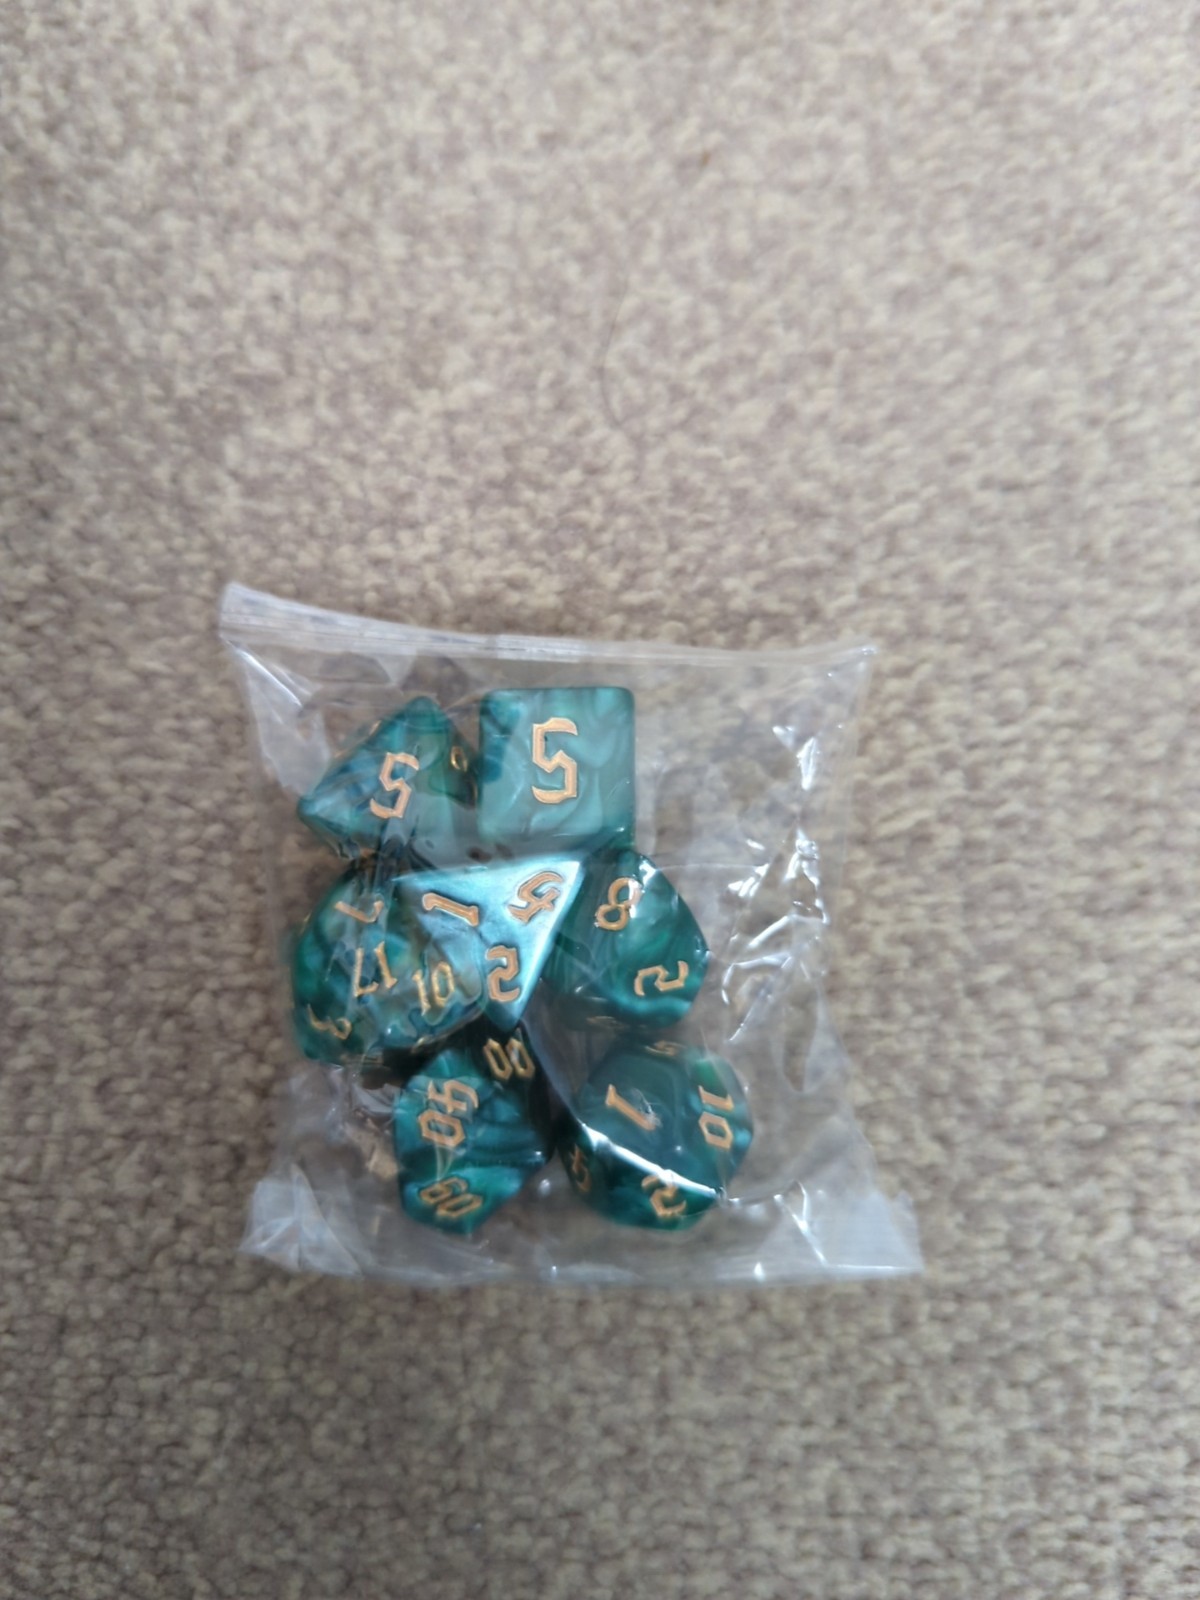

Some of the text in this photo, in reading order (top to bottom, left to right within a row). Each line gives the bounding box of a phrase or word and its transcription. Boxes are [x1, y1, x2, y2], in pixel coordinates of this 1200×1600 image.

[369, 752, 419, 819] 5
[532, 717, 578, 804] 5
[334, 894, 384, 923] 7
[422, 892, 479, 926] 1
[594, 877, 640, 931] 8
[353, 941, 398, 997] 17
[412, 962, 455, 1016] 10
[486, 945, 520, 1002] 2
[633, 960, 689, 997] 2
[483, 1037, 535, 1081] 00
[418, 1079, 479, 1147] 40
[605, 1084, 661, 1131] 1
[698, 1085, 734, 1149] 10
